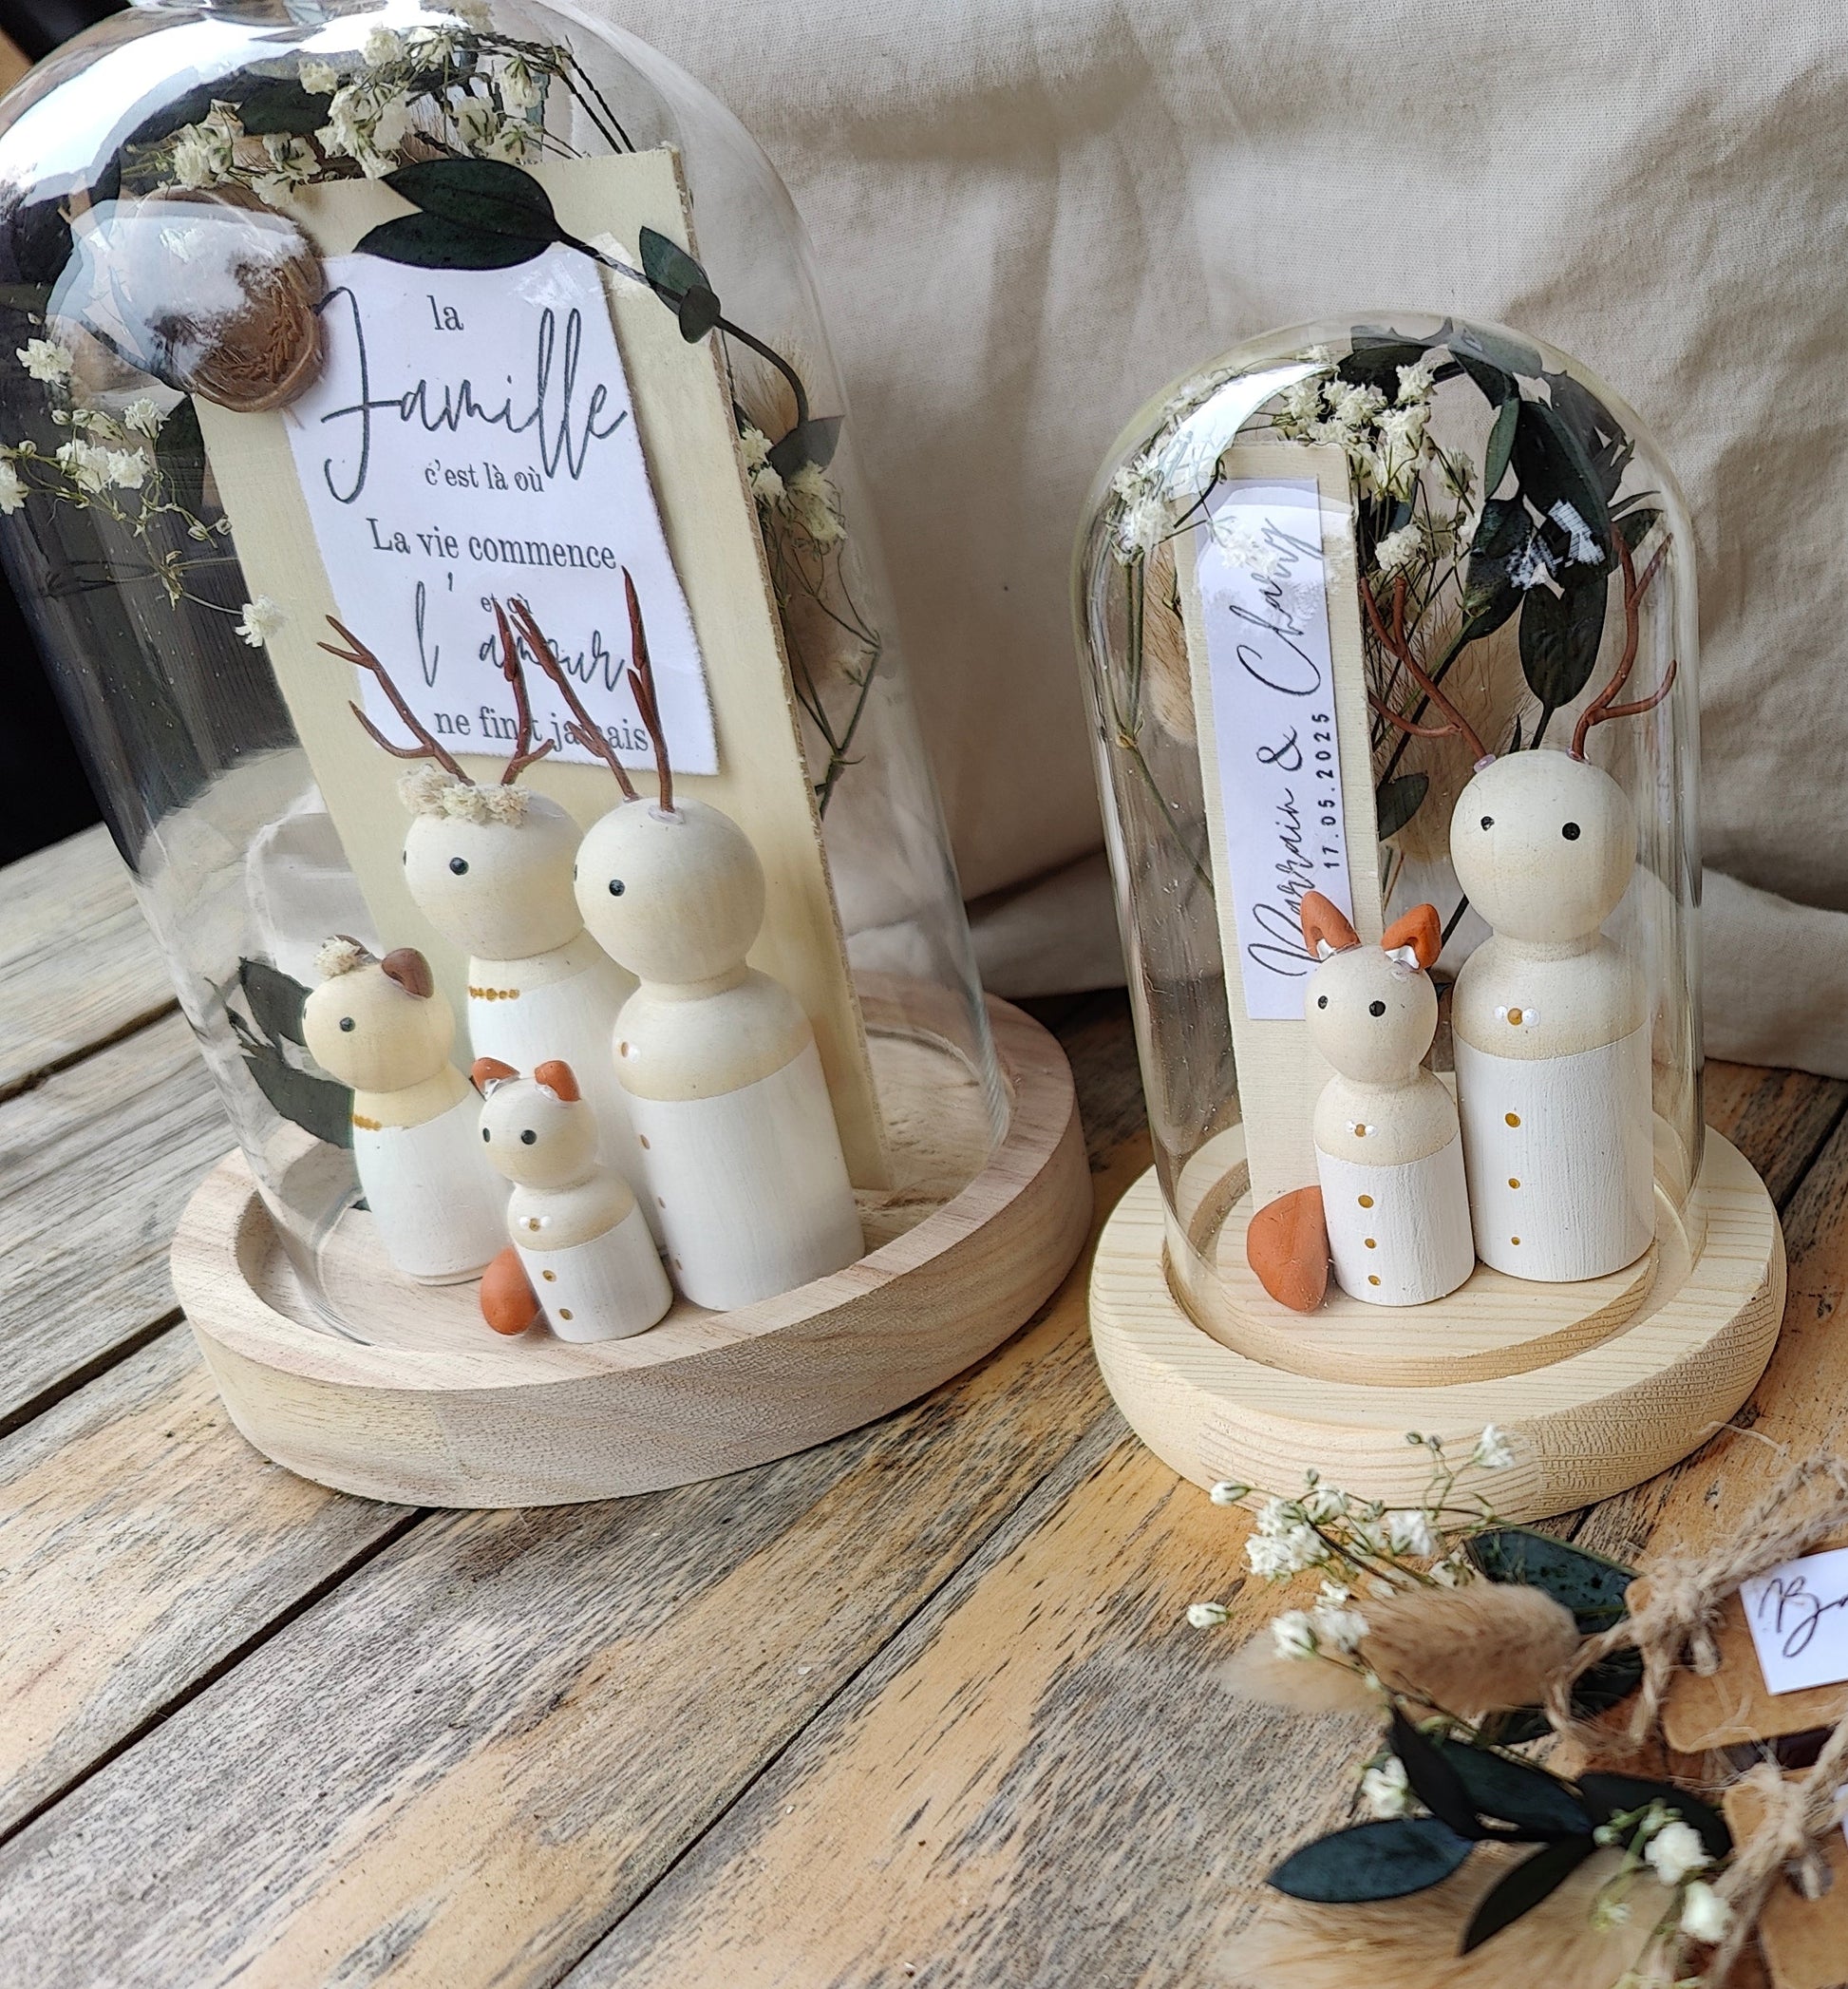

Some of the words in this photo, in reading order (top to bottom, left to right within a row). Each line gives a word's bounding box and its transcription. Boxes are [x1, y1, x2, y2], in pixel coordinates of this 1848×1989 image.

[428, 294, 463, 331] la
[486, 462, 510, 490] là
[516, 466, 546, 493] où
[366, 518, 411, 554] La
[417, 528, 459, 559] vie
[468, 537, 617, 570] commence
[434, 709, 471, 738] ne
[479, 706, 543, 741] fint
[550, 712, 650, 752] jaais
[1256, 726, 1304, 771] &
[1311, 712, 1340, 869] 17.05.2025
